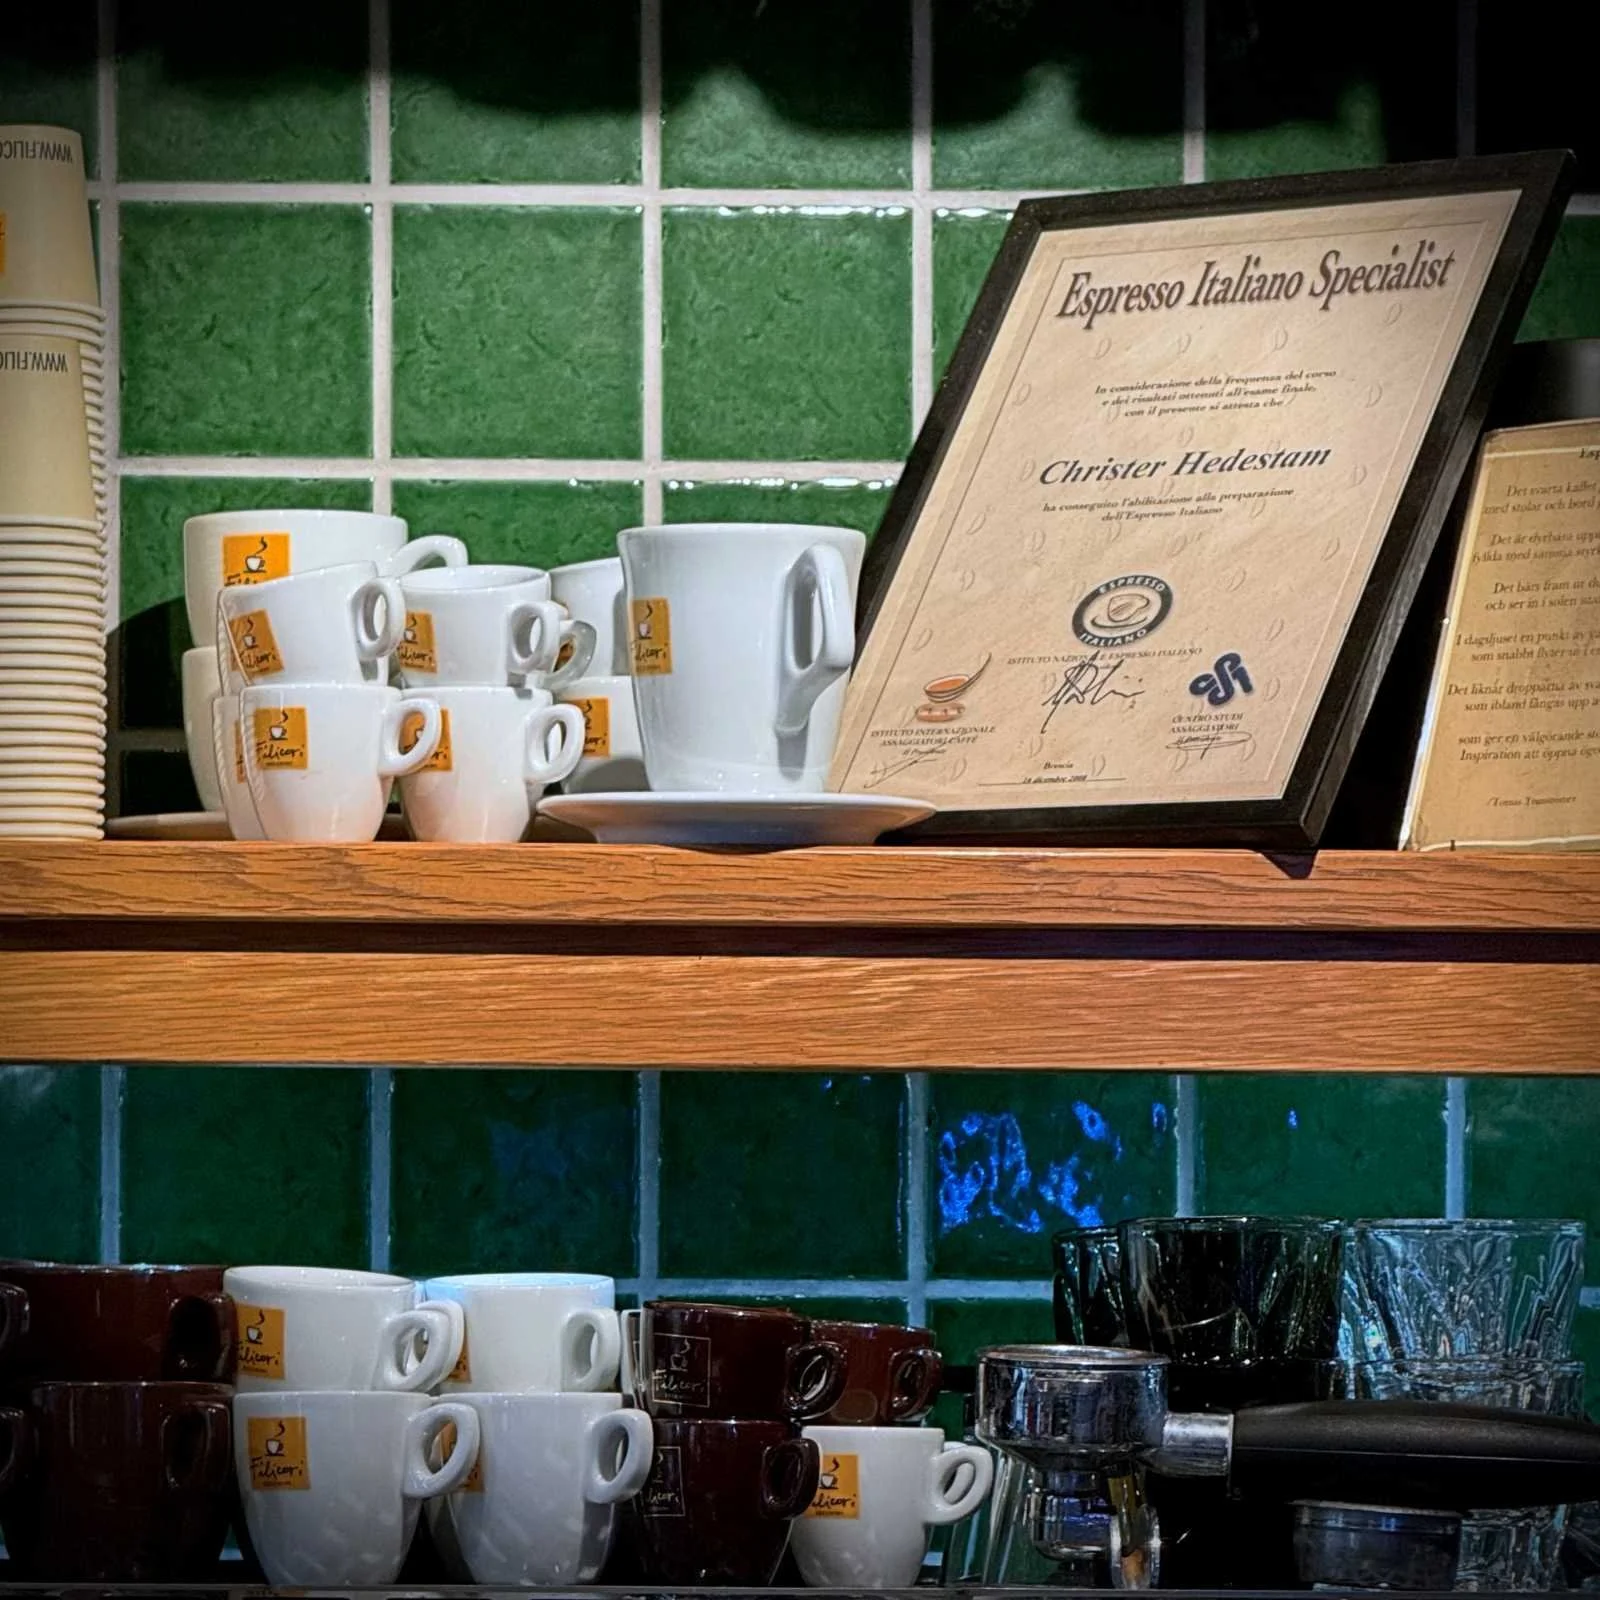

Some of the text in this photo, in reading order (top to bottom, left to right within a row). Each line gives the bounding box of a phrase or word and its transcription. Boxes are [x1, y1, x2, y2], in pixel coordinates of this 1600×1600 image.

[1055, 239, 1456, 331] Espresso Italiano Specialist
[1109, 378, 1192, 394] considerazione
[1194, 375, 1222, 387] della
[1224, 374, 1282, 389] frequenza
[1284, 369, 1304, 381] del
[1111, 395, 1130, 406] dei
[1131, 391, 1177, 405] risultati
[1124, 407, 1145, 417] con
[1147, 406, 1156, 417] il
[1157, 403, 1207, 417] presente
[1262, 396, 1284, 408] che
[1039, 448, 1333, 485] Christer Hedestam
[1042, 501, 1058, 512] ha
[1195, 491, 1217, 503] alla
[1218, 487, 1295, 503] preparazione
[1097, 574, 1166, 594] ESPRESSO
[1079, 628, 1148, 648] ITALIANO
